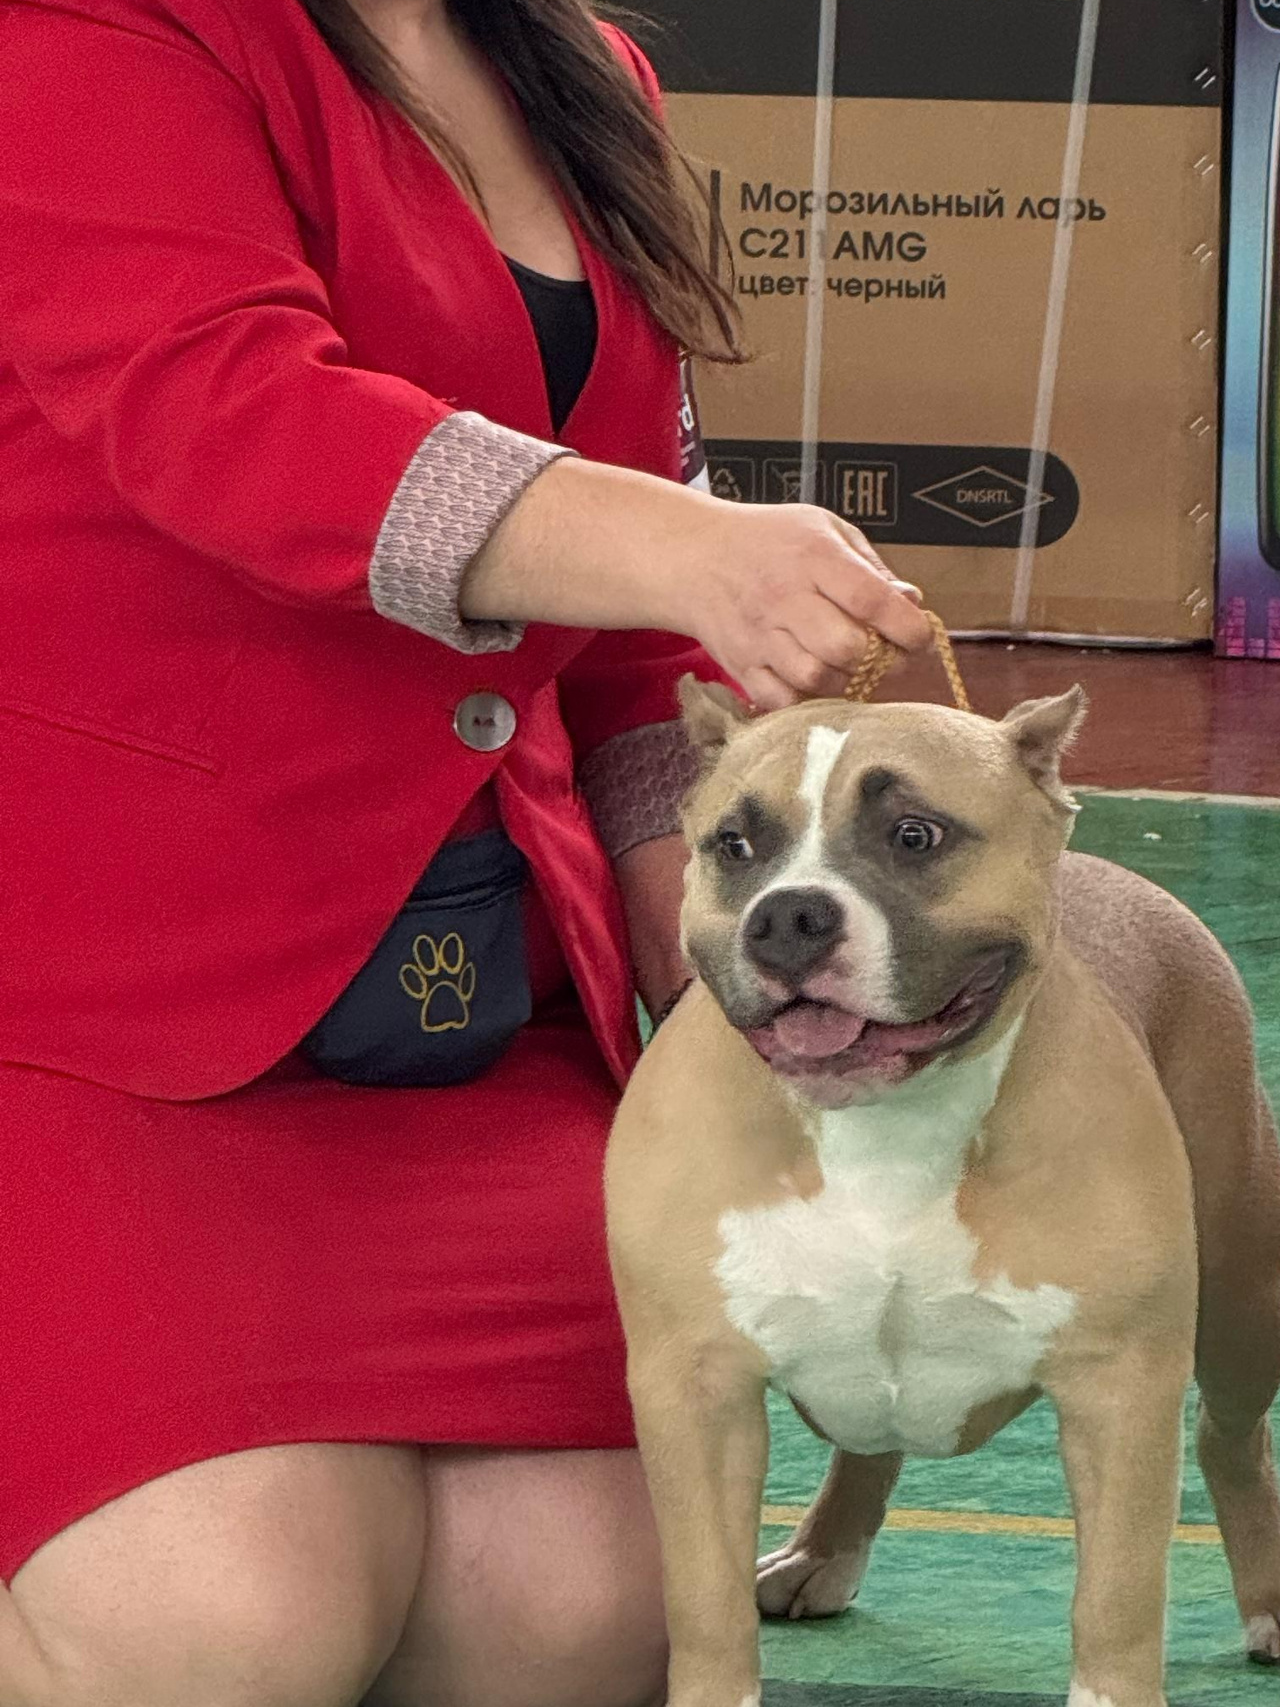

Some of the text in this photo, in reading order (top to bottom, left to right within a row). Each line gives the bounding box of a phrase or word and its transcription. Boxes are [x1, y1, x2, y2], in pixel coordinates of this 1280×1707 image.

[741, 182, 1107, 228] Морозильный ларь
[832, 230, 928, 263] AMG
[738, 273, 947, 304] цвет черный
